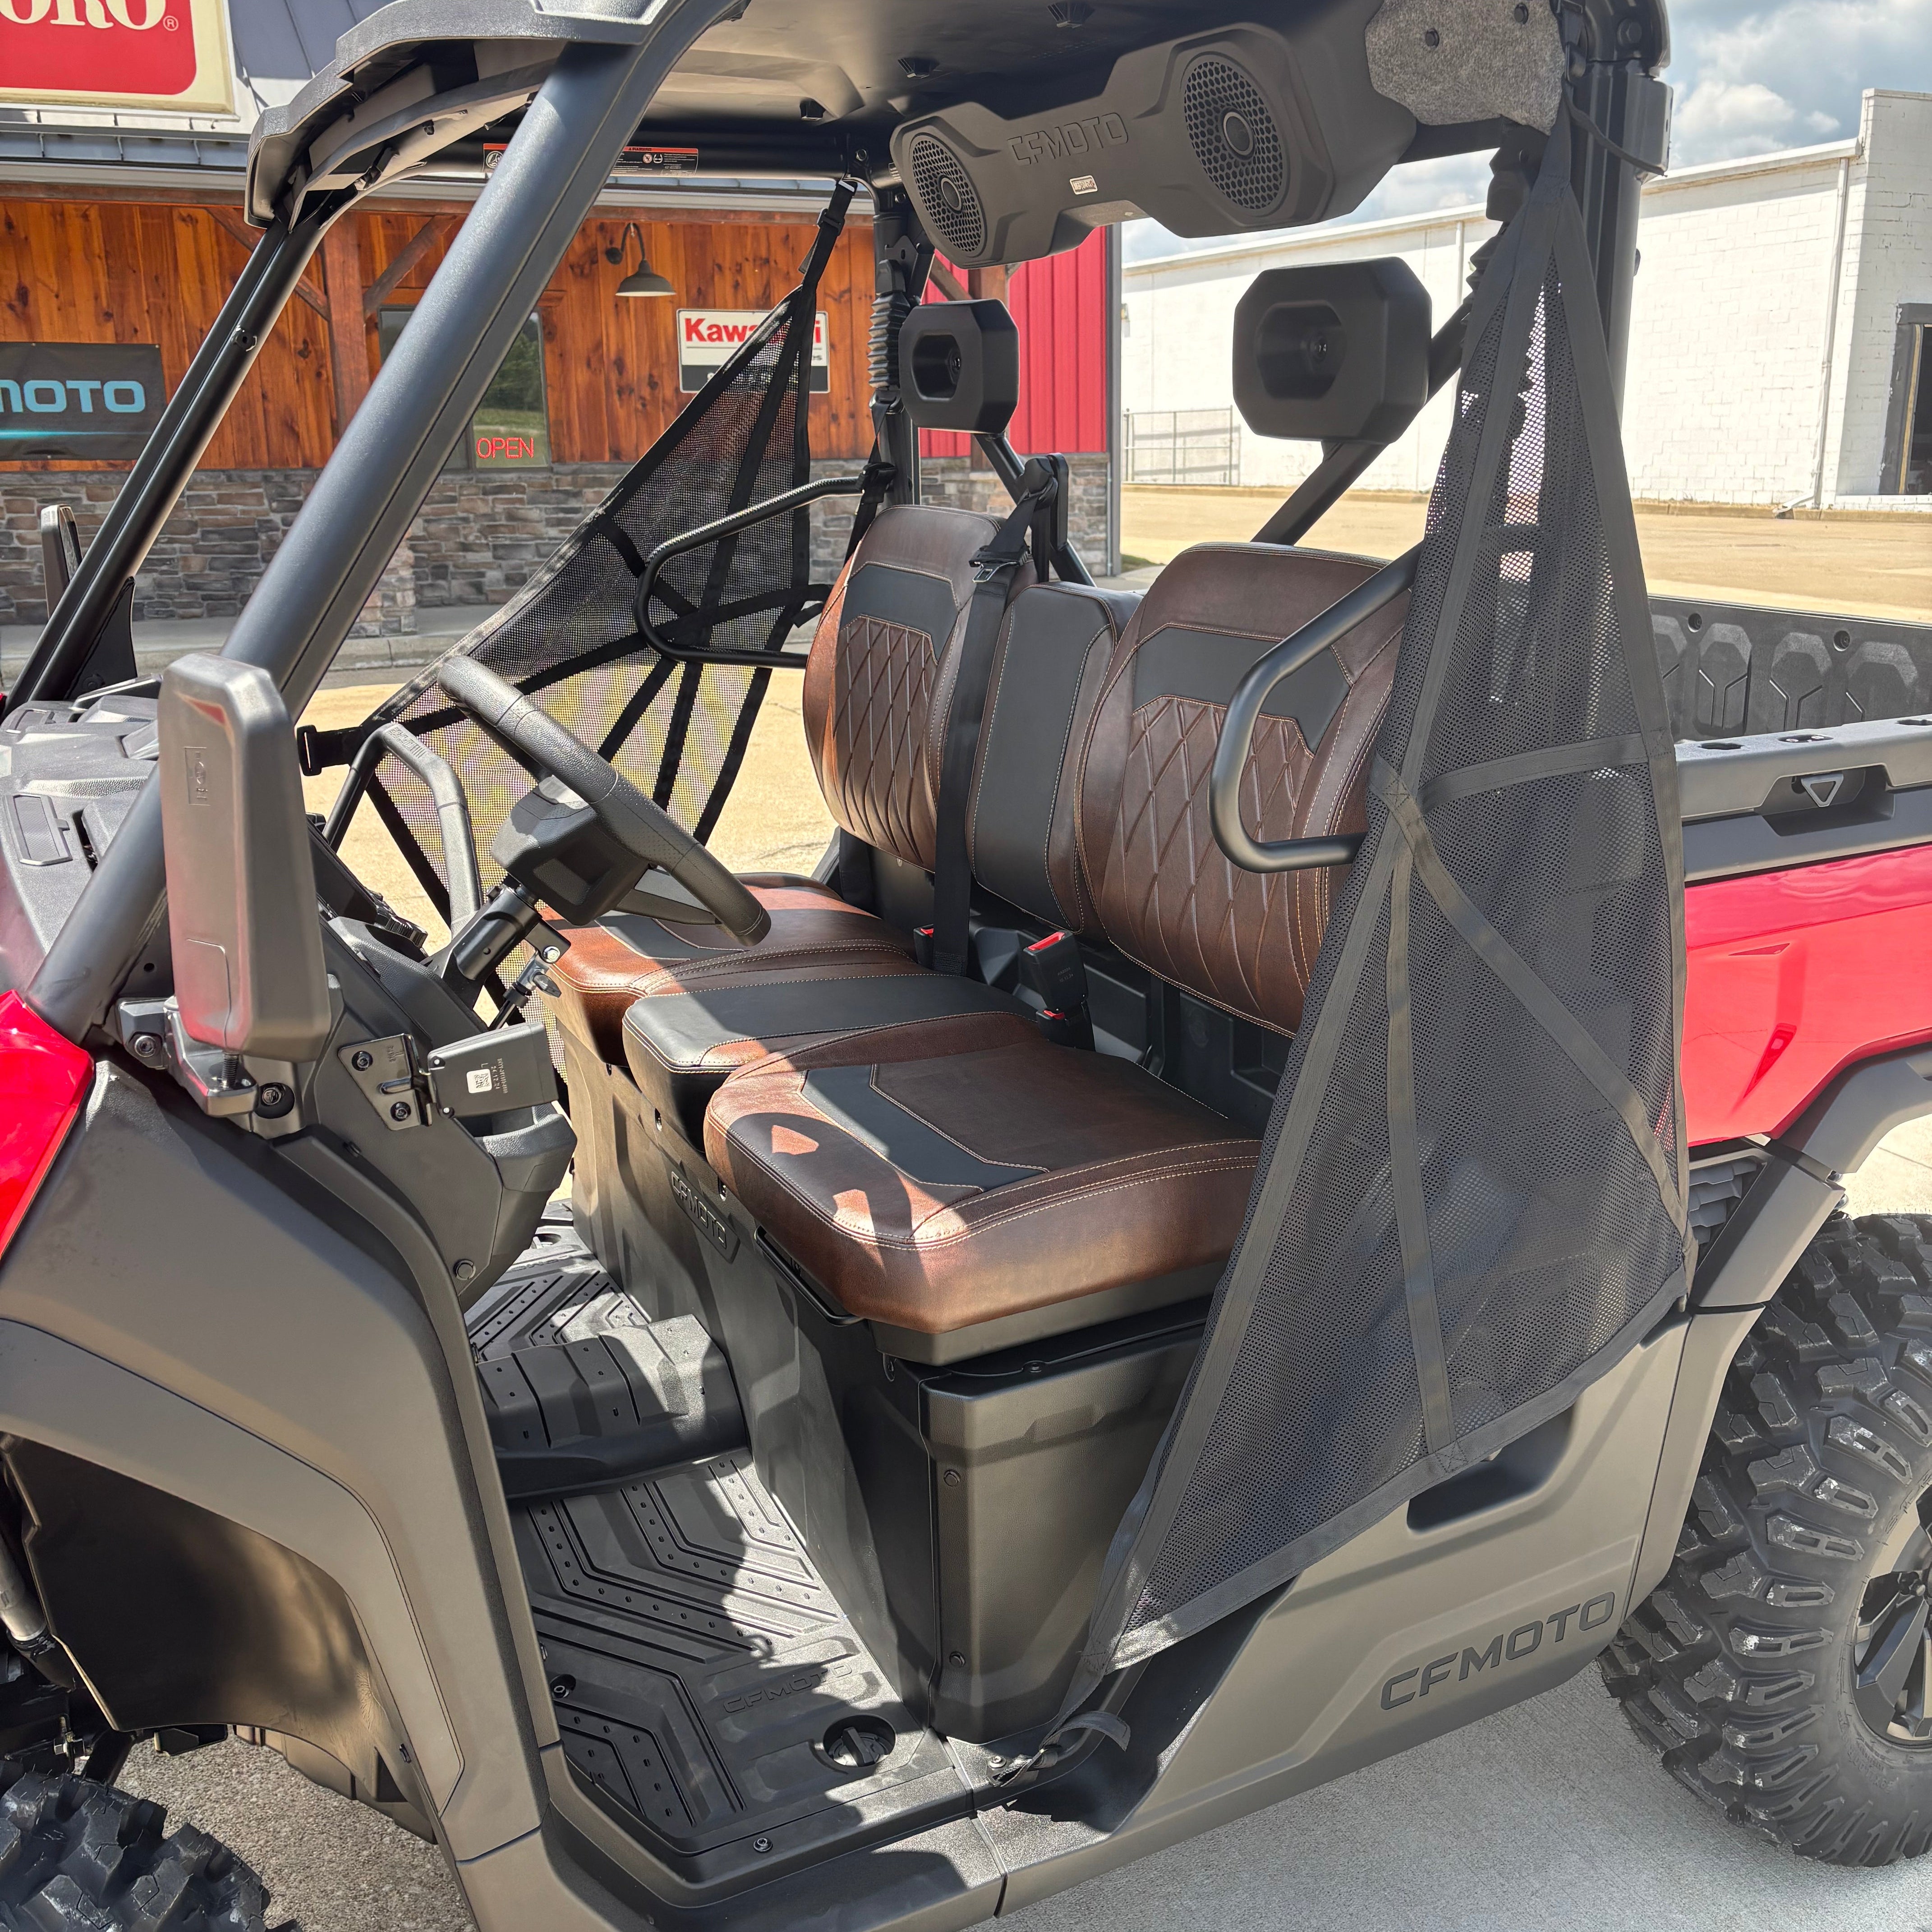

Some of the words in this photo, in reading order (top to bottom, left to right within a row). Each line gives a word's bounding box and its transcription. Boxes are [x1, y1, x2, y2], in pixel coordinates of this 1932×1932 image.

[1007, 112, 1128, 166] CFMOTO
[476, 437, 534, 459] OPEN
[672, 1171, 727, 1249] CFMOTO
[1380, 1592, 1615, 1710] CFMOTO
[722, 1664, 853, 1713] CFMOTO
